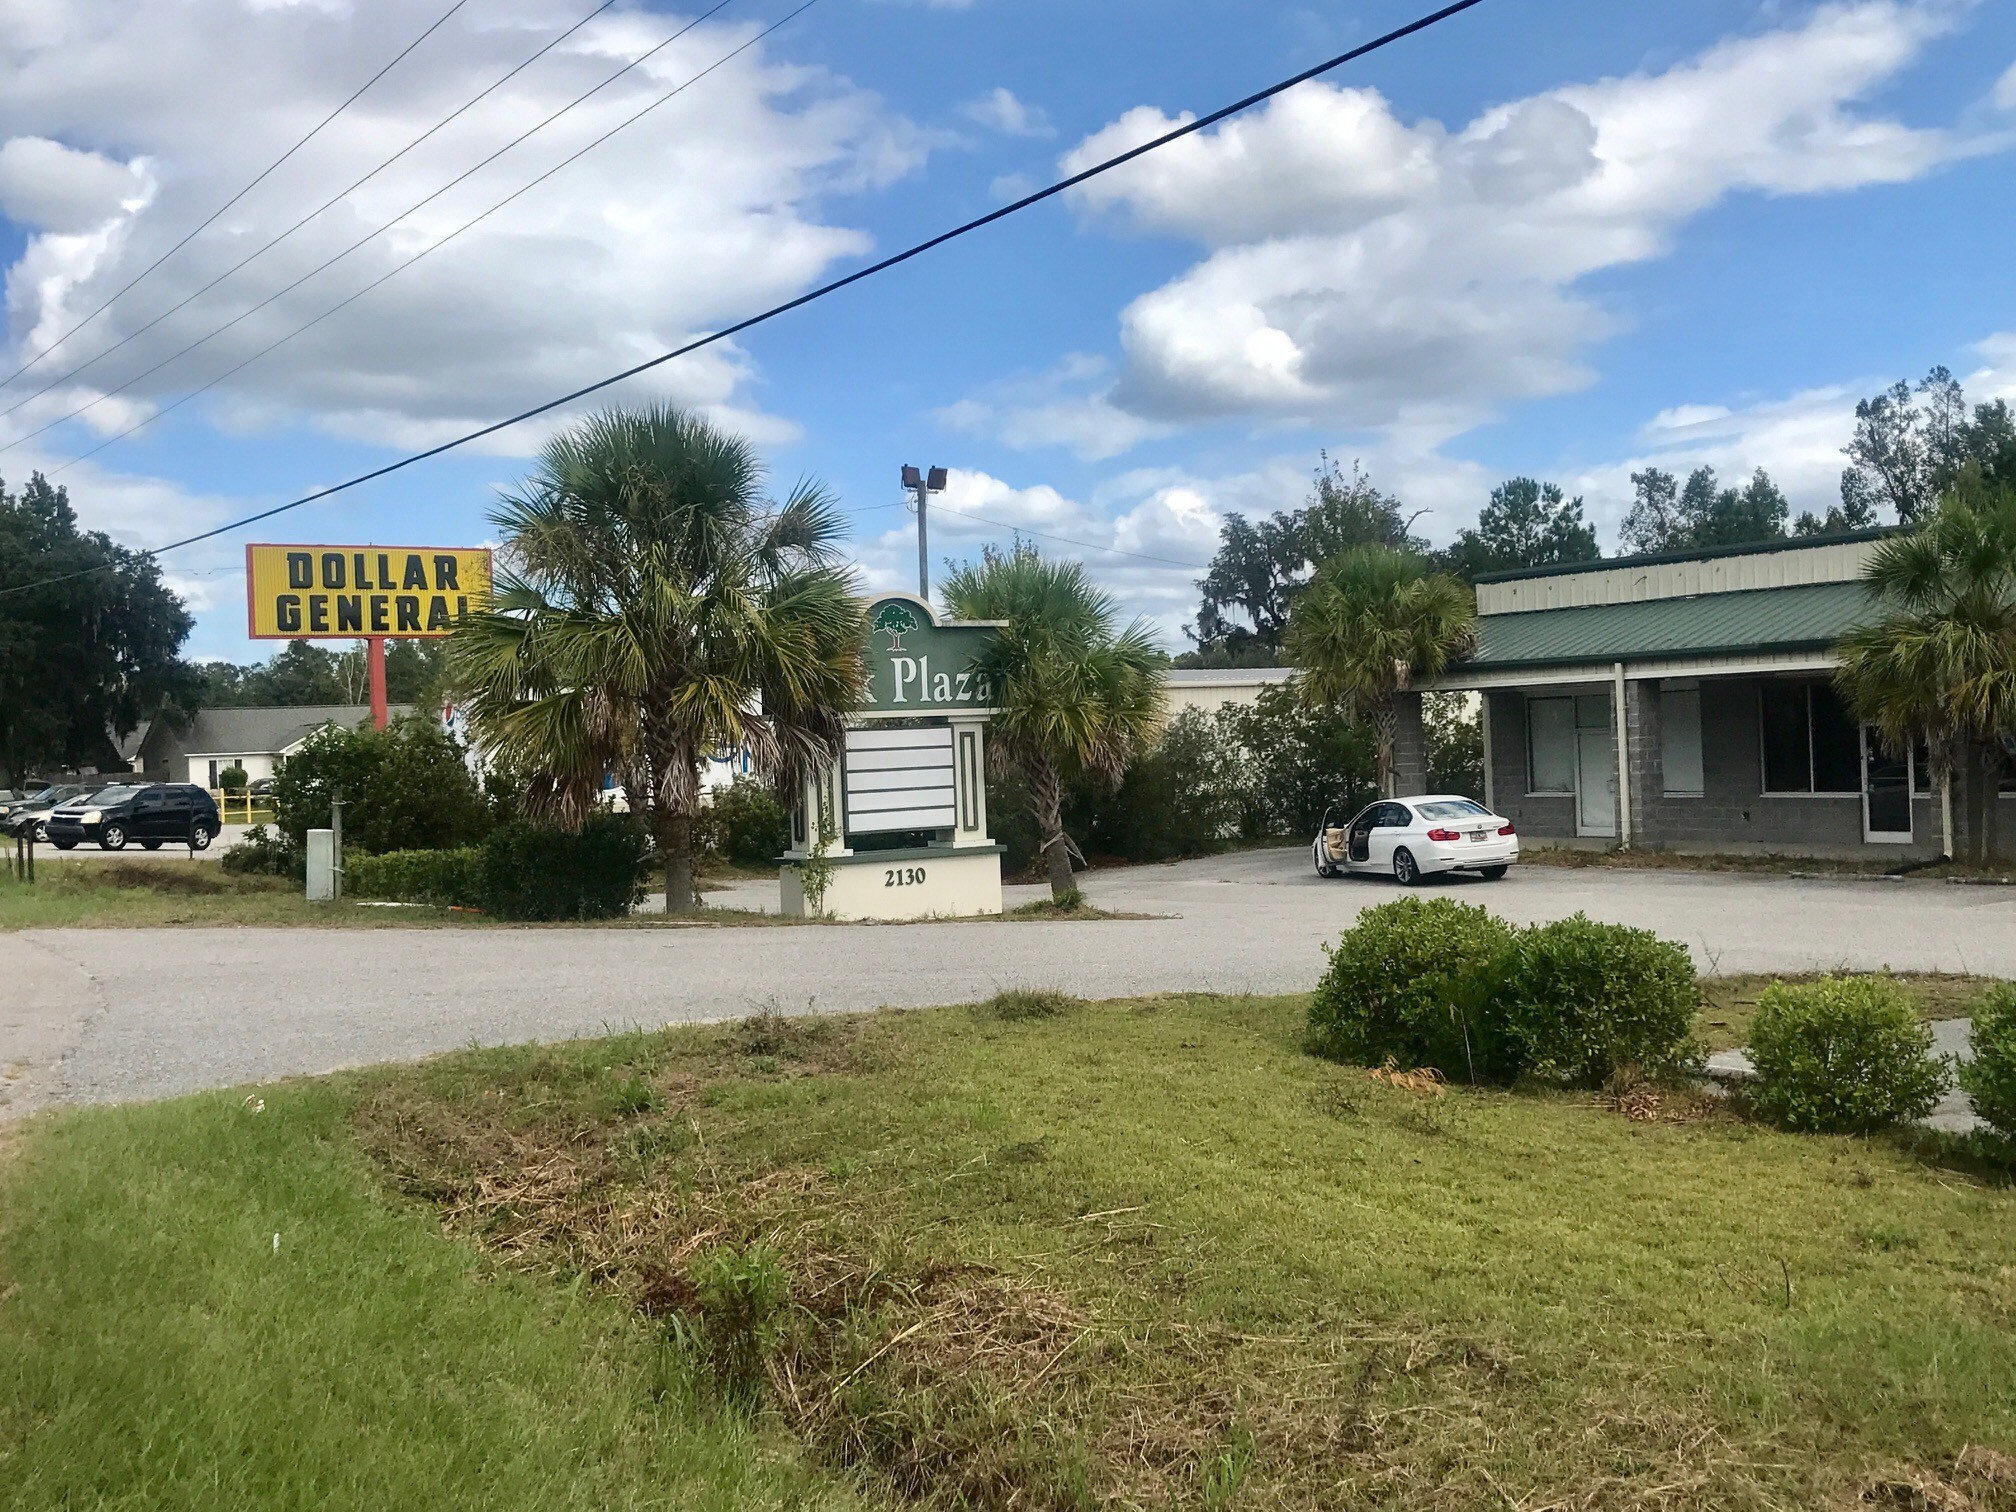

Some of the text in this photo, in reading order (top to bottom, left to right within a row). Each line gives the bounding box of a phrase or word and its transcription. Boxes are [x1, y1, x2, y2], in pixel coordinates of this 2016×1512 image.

[287, 552, 460, 590] DOLLAR
[890, 655, 993, 703] Plaza
[884, 867, 926, 887] 2130
